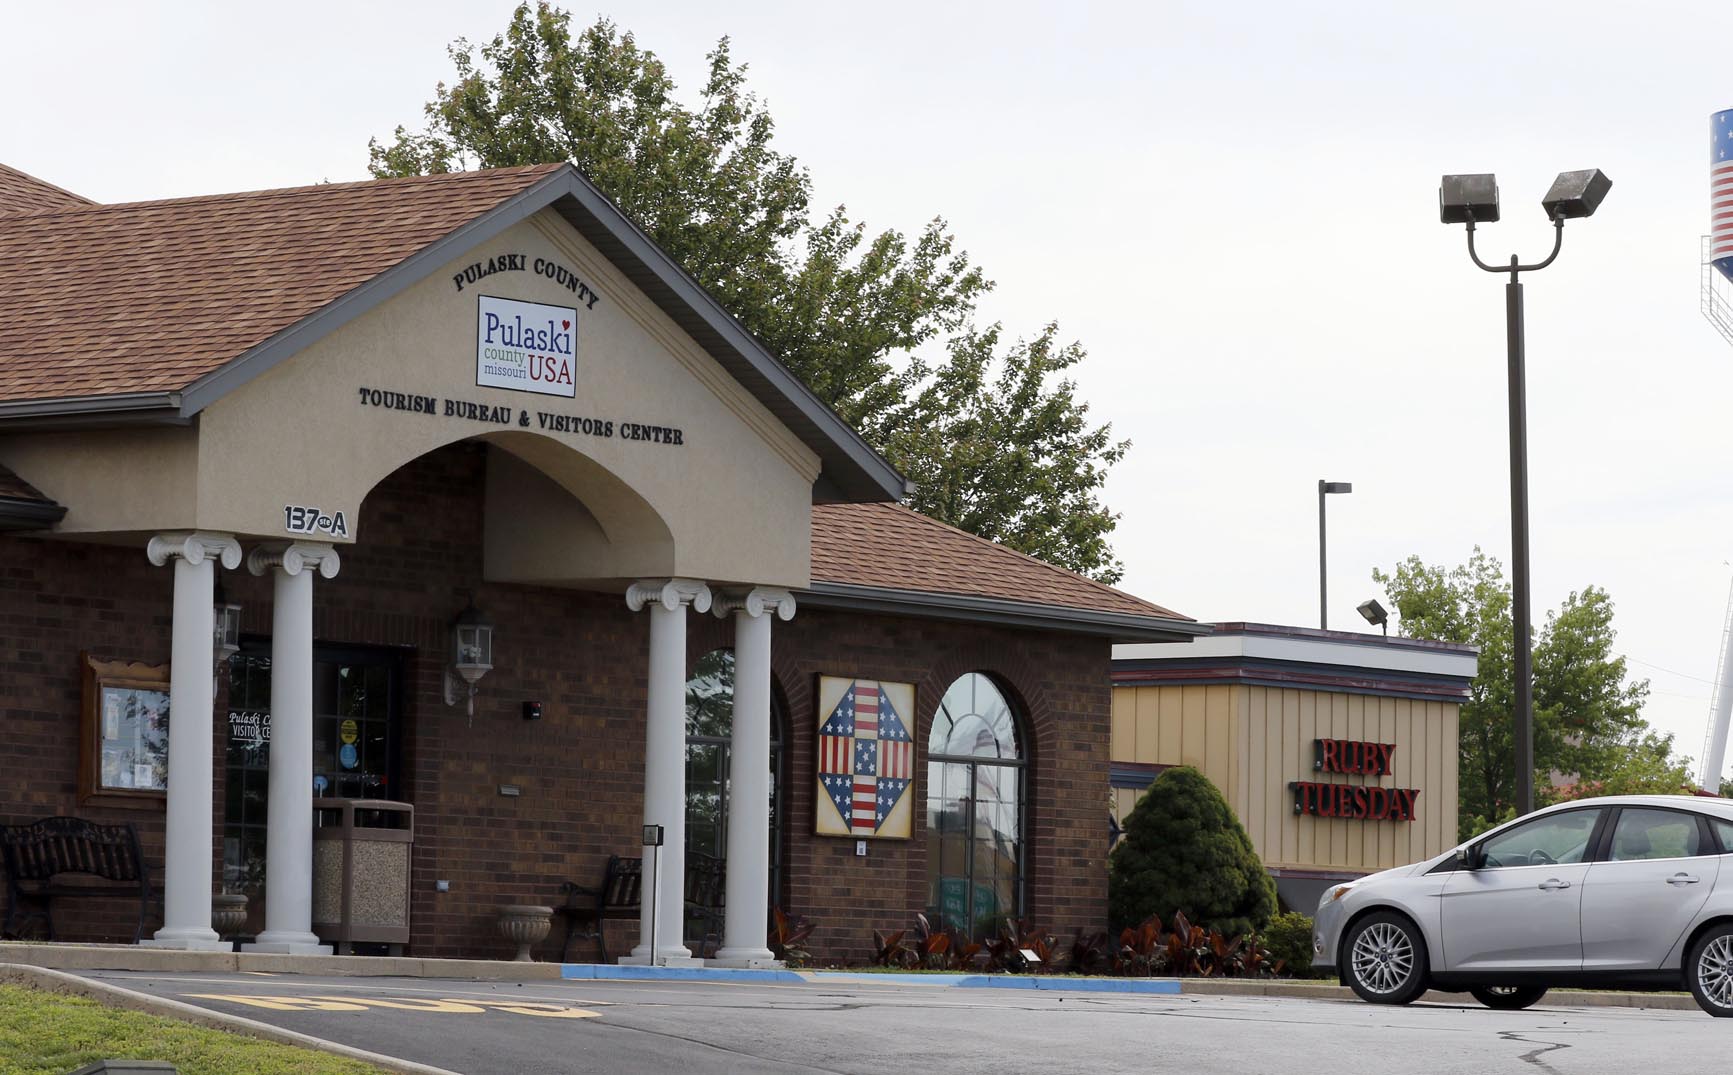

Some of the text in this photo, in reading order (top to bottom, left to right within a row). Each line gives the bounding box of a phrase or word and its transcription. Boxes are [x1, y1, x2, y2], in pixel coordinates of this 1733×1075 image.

[453, 254, 599, 310] PULASKI COUNTY
[484, 312, 572, 355] Pulaski
[484, 347, 526, 368] county
[484, 362, 527, 379] missouri
[528, 354, 572, 385] USA
[359, 387, 684, 445] TOURISM BUREAU & VISITORS CENTER
[284, 505, 320, 532] 137
[229, 711, 260, 727] Pulaski
[233, 724, 260, 737] VISITOR
[1319, 738, 1397, 776] RUBY
[1295, 781, 1421, 821] TUESDAY
